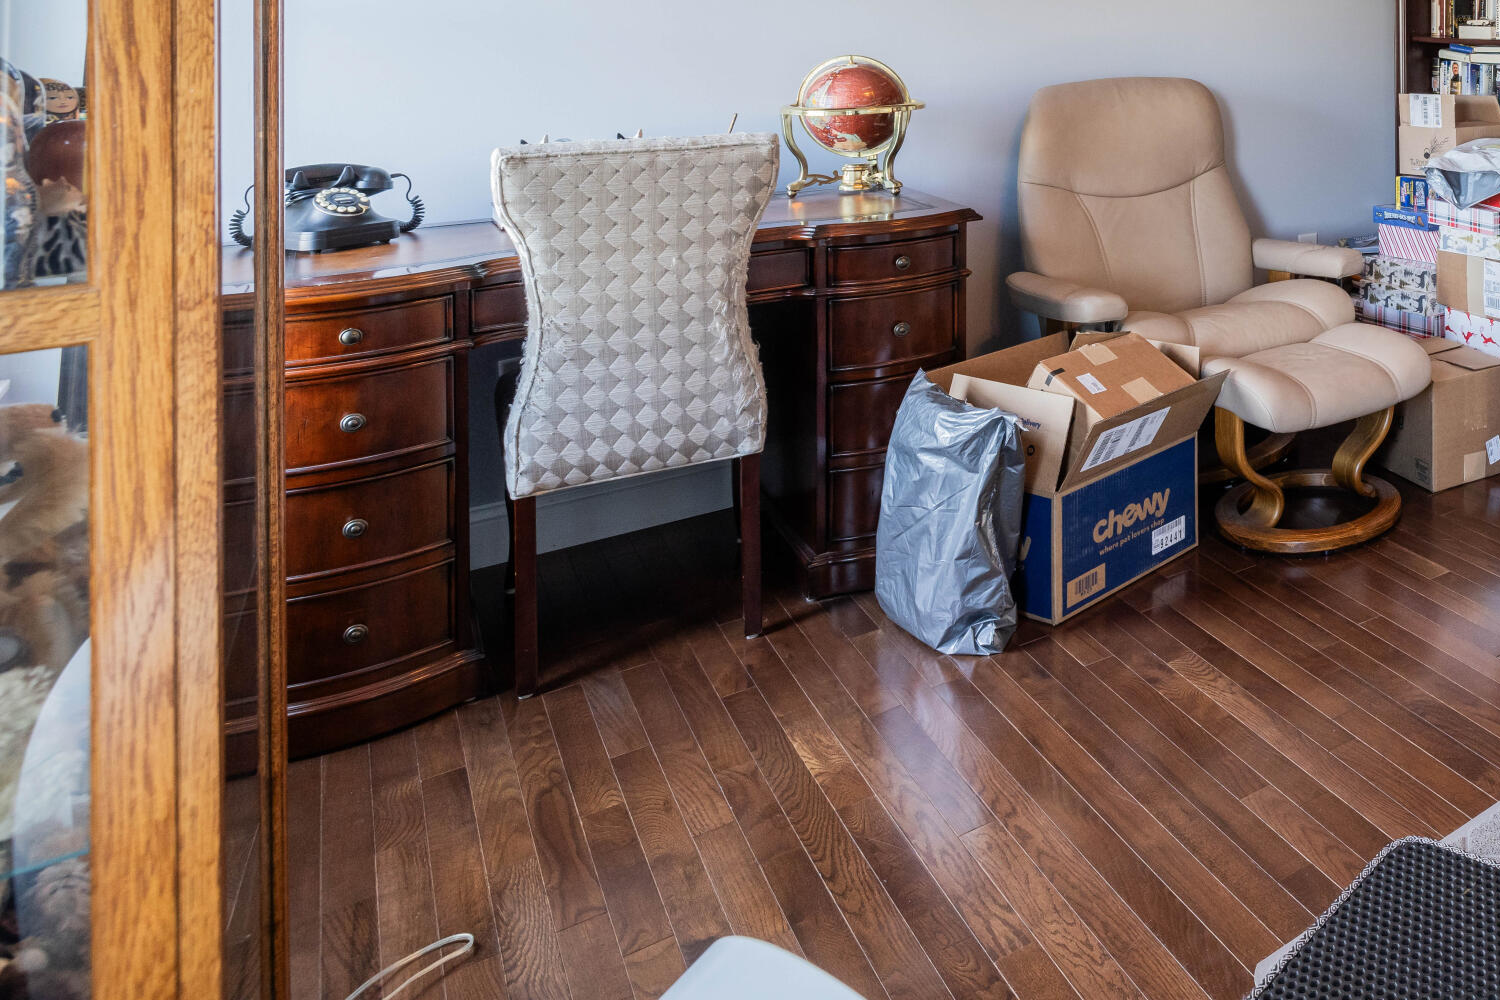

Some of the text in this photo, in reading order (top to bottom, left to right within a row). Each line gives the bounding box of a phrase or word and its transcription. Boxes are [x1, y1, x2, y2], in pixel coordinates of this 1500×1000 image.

[1093, 487, 1171, 544] chewy
[1098, 517, 1165, 556] where pet lovers shop
